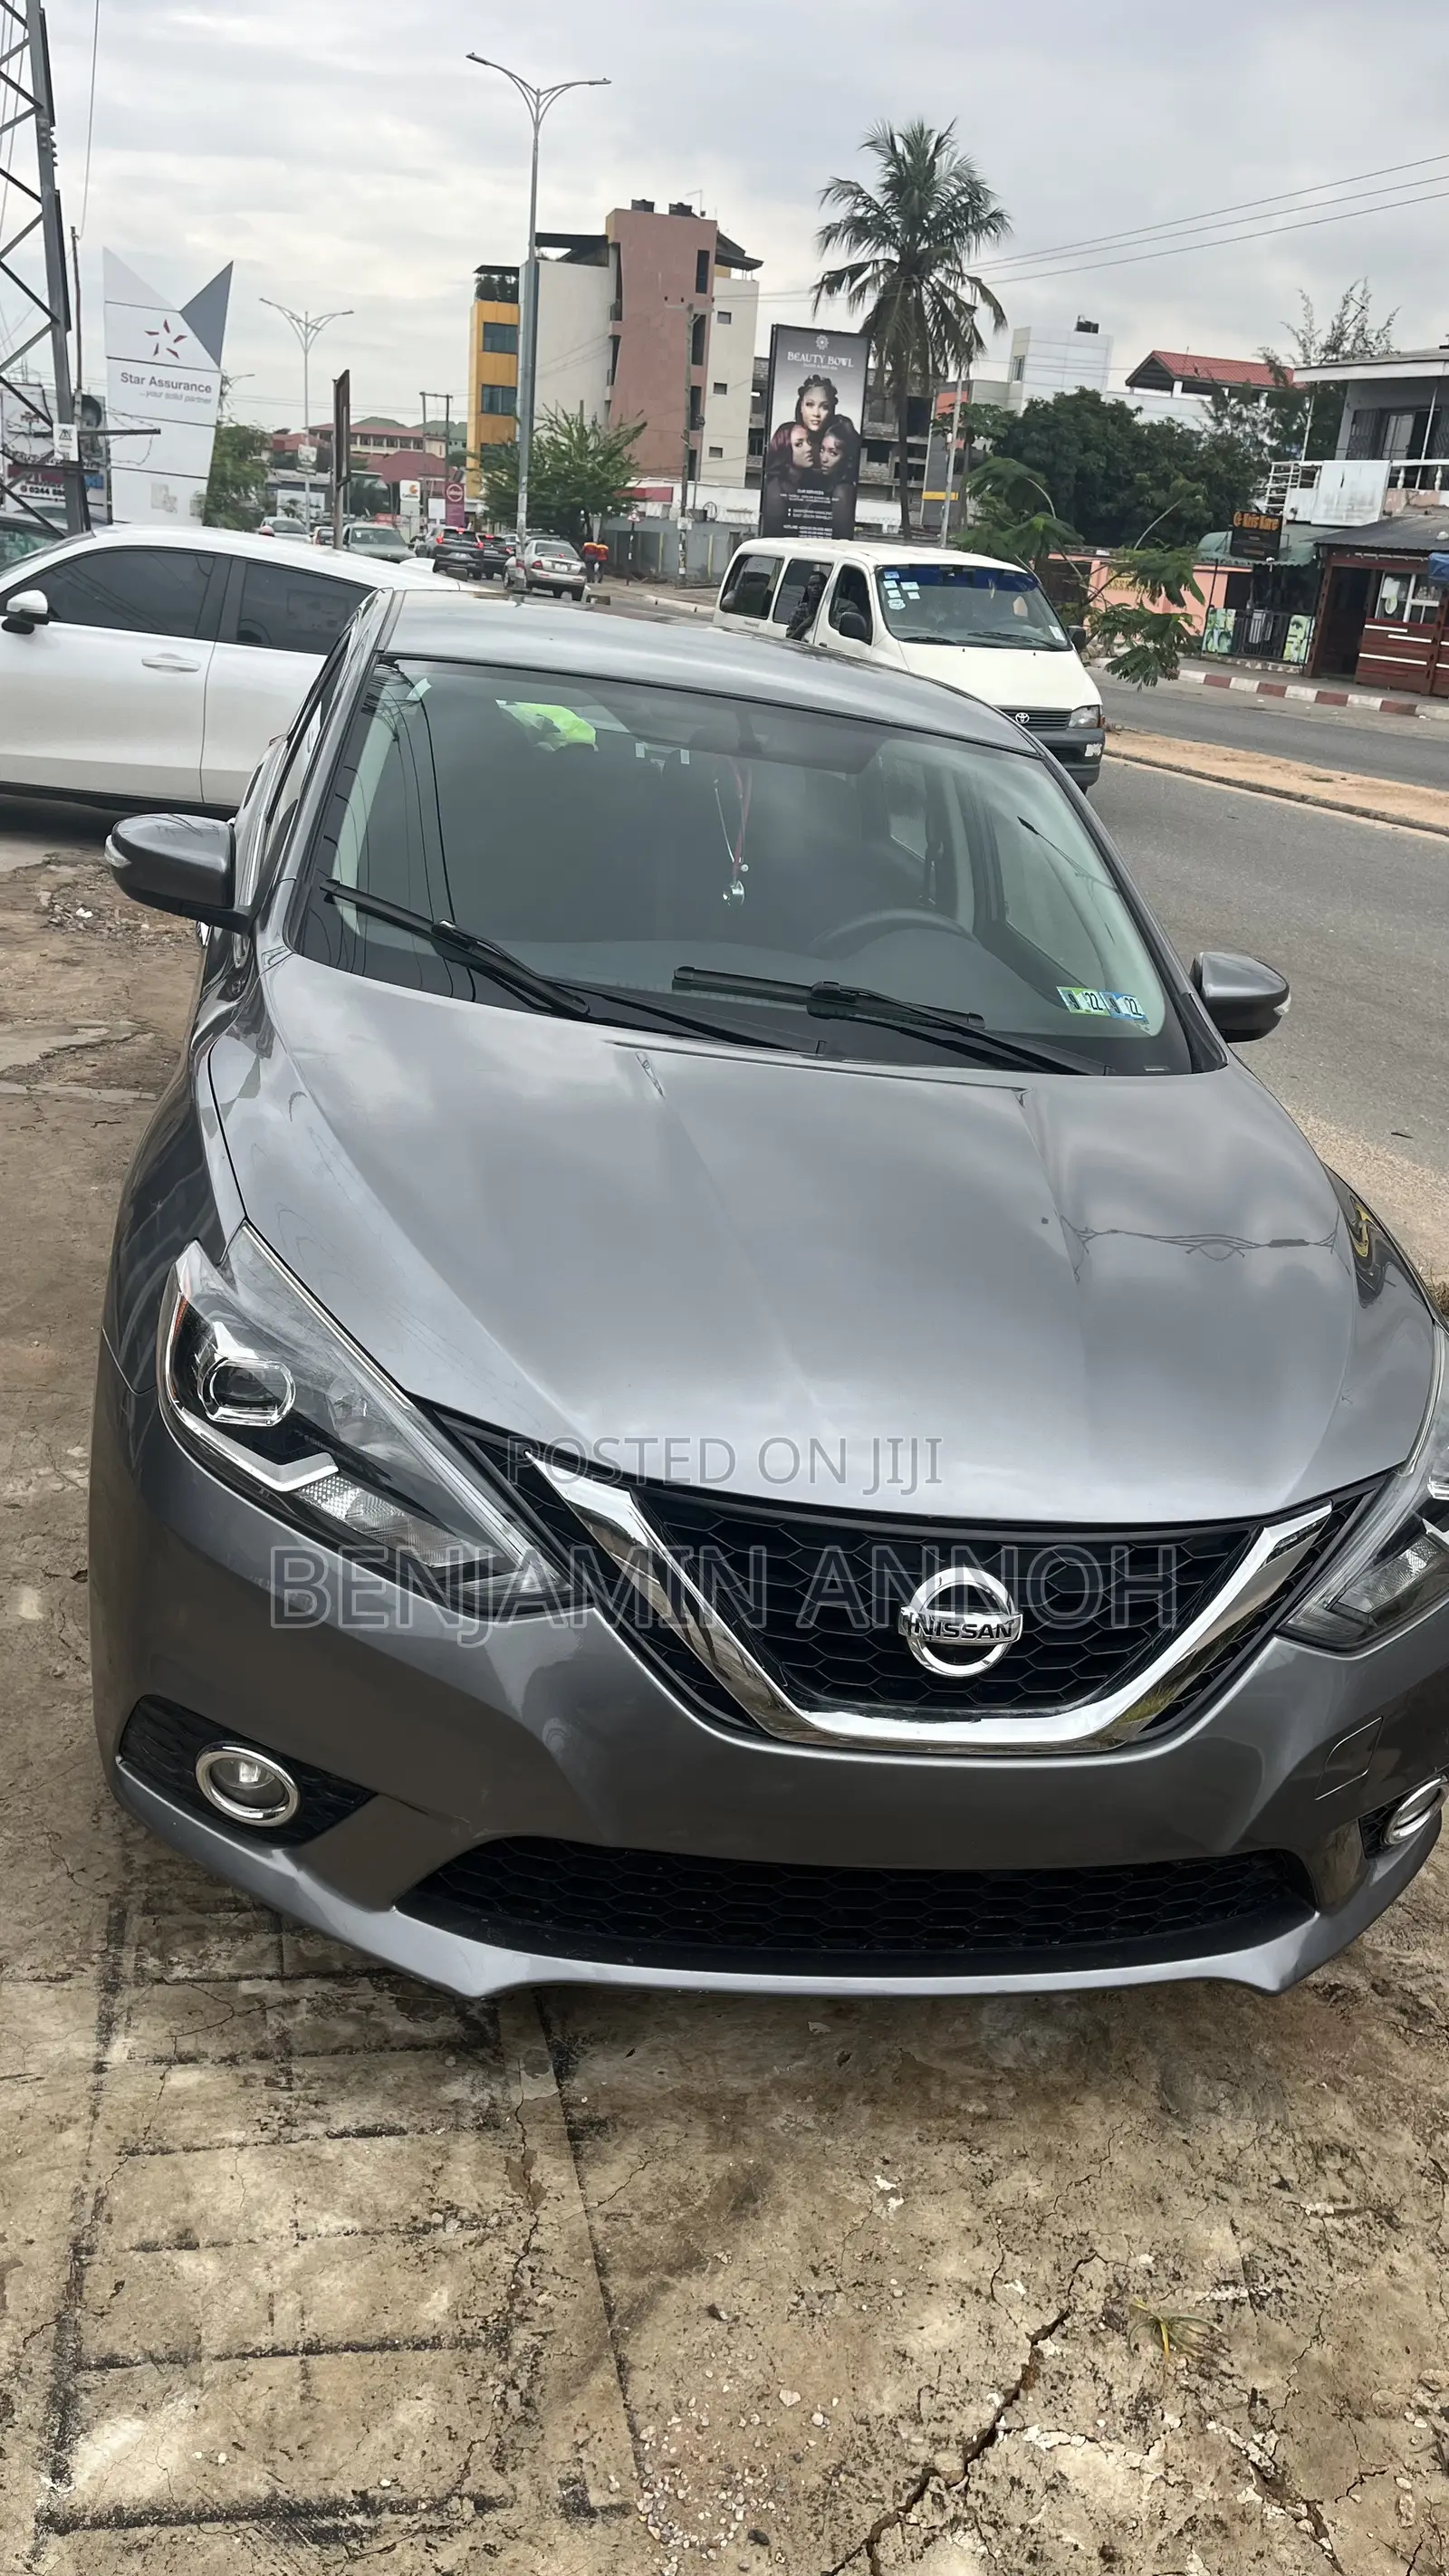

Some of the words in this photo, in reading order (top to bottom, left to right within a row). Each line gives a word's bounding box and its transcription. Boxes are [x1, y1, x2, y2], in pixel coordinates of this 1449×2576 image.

[787, 351, 825, 364] BEAUTY
[828, 356, 854, 368] BOWL
[120, 372, 146, 385] Star
[149, 376, 212, 393] Assurance
[1085, 992, 1104, 1010] 22
[1124, 997, 1143, 1017] 22
[914, 1618, 1012, 1641] NISSAN
